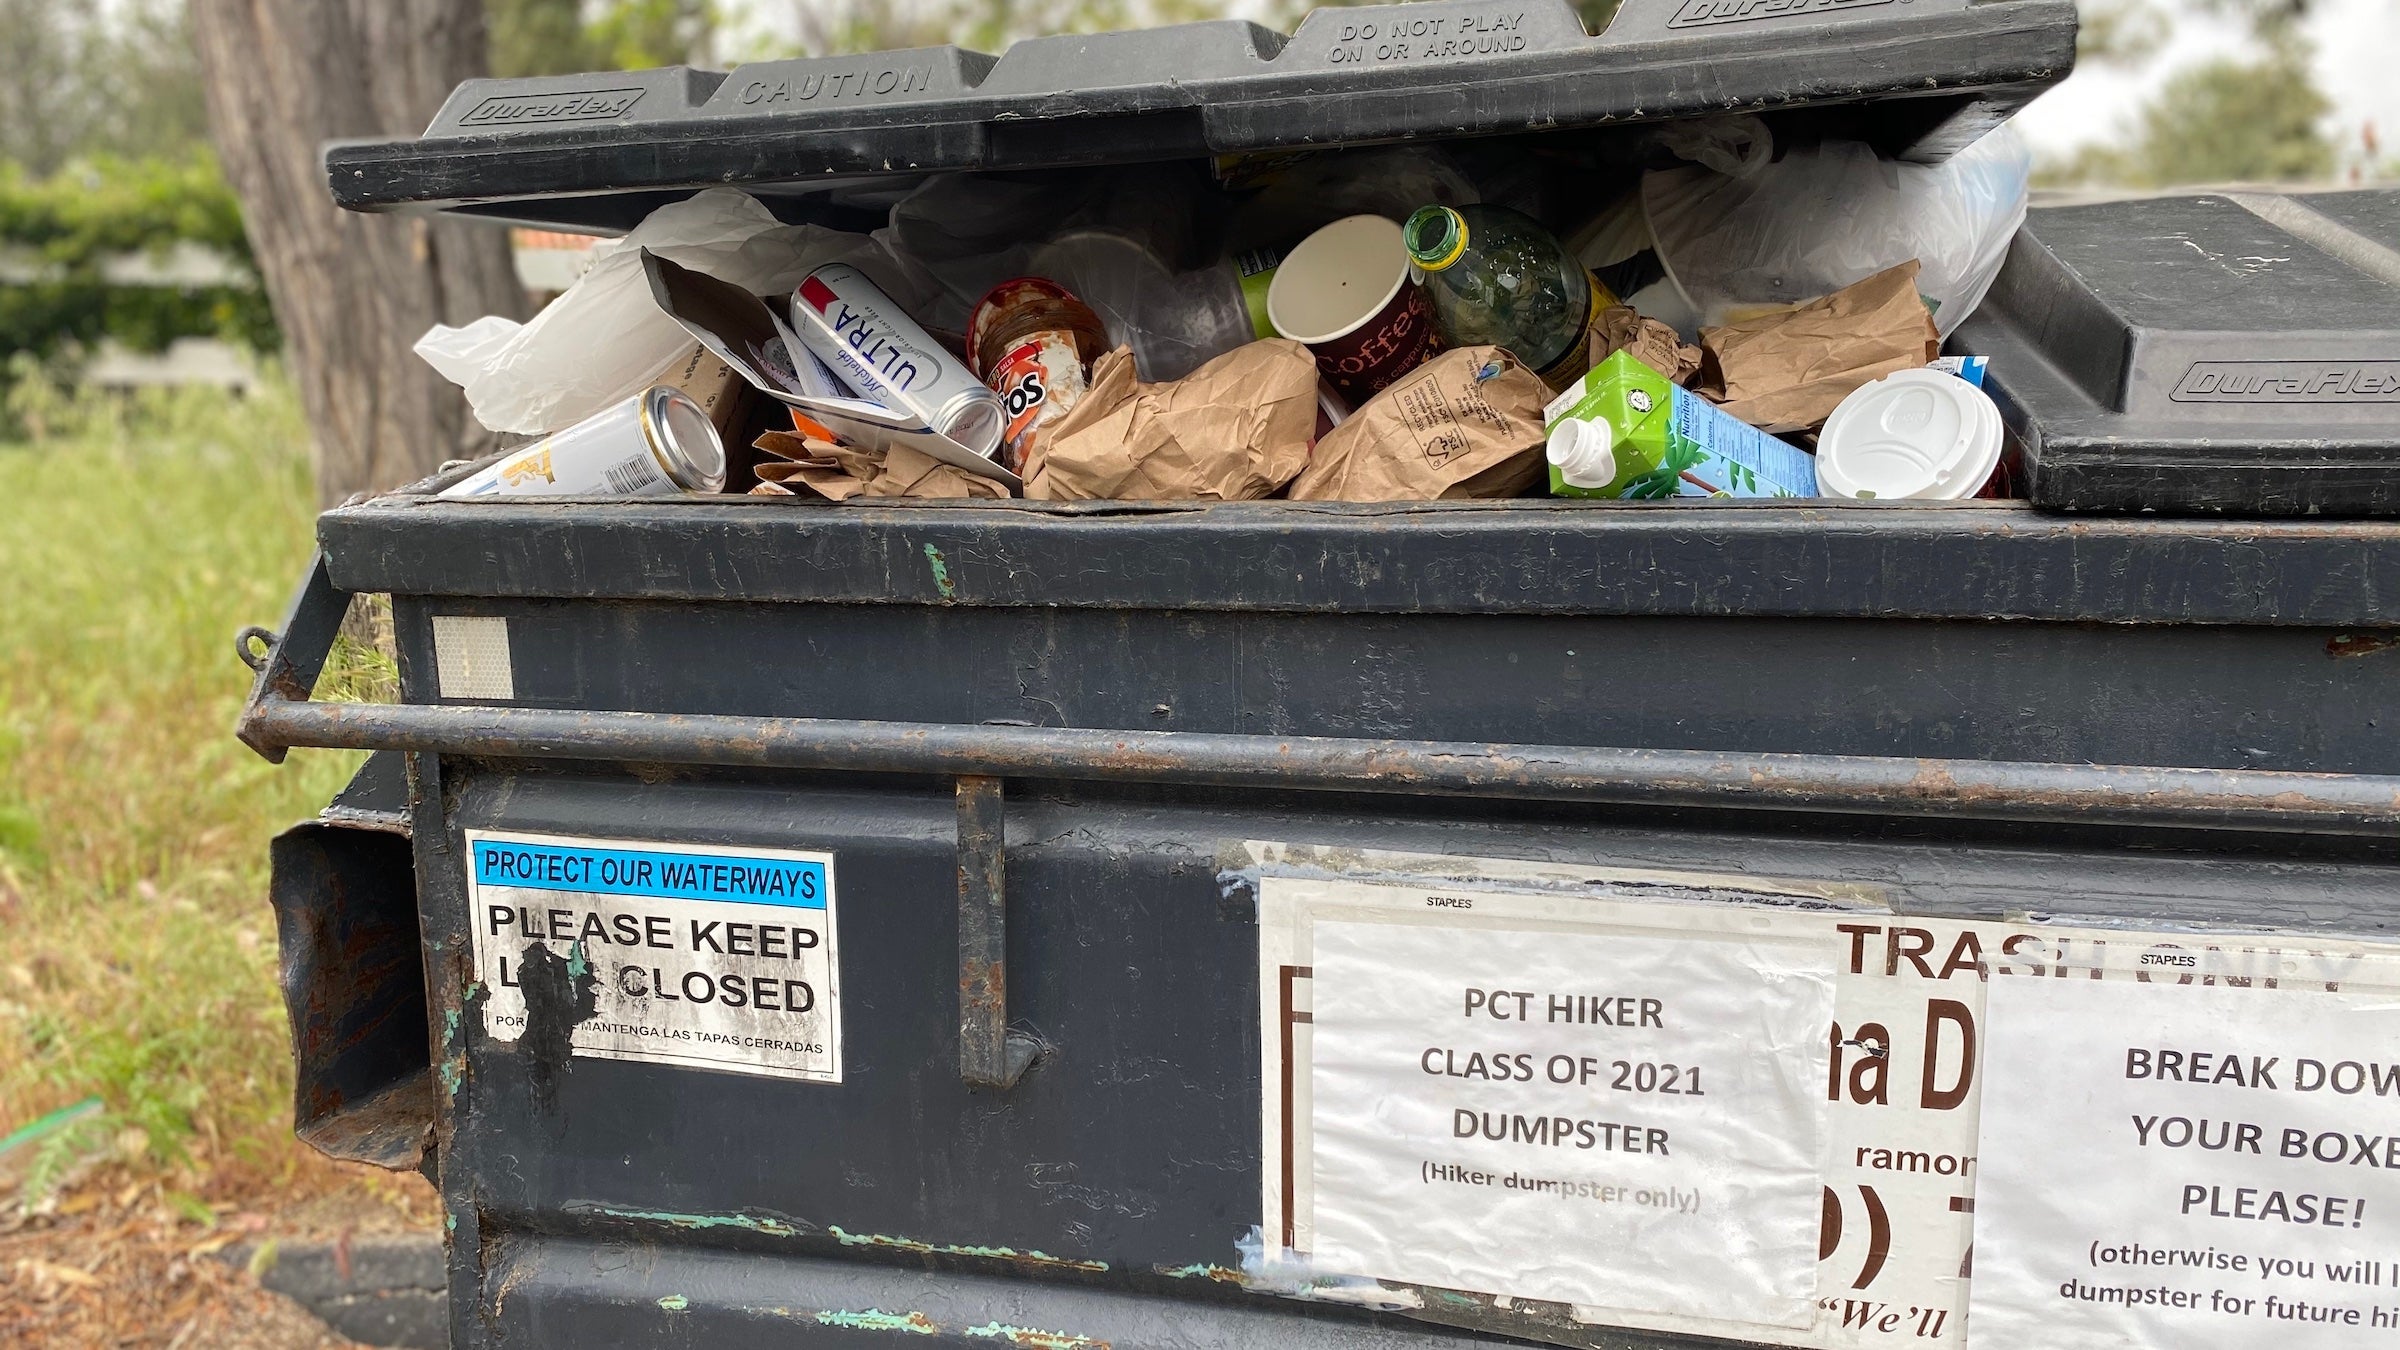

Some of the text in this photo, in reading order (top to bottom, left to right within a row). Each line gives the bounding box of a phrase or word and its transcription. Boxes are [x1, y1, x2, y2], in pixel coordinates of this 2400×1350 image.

[1341, 13, 1525, 42] DO NOT PLAY
[1329, 35, 1527, 63] ON OR AROUND
[741, 64, 932, 105] CAUTION
[833, 303, 917, 393] ULTRA
[837, 349, 890, 402] Michelob
[1402, 394, 1426, 432] RECYCLED
[1680, 393, 1691, 438] Nutrition
[1444, 429, 1460, 451] FSC
[1706, 420, 1714, 449] Calories
[485, 849, 816, 900] PROTECT OUR WATERWAYS
[1426, 896, 1473, 910] STAPLES
[488, 905, 820, 960] PLEASE KEEP
[2140, 953, 2196, 968] STAPLES
[619, 964, 815, 1013] CLOSED
[1464, 988, 1665, 1030] PCT HIKER
[495, 1015, 526, 1027] POR
[581, 1021, 824, 1055] MANTENGA LAS TAPAS CERRADAS
[1420, 1047, 1706, 1097] CLASS OF 2021
[2125, 1048, 2279, 1090] BREAK
[1453, 1108, 1671, 1156] DUMPSTER
[2131, 1114, 2263, 1155] YOUR
[1421, 1160, 1702, 1215] (Hiker dumpster only)
[2180, 1184, 2366, 1229] PLEASE!
[2088, 1240, 2248, 1273] (otherwise
[2258, 1255, 2315, 1280] you
[2325, 1261, 2381, 1287] will
[2059, 1278, 2202, 1314] dumpster
[2210, 1284, 2256, 1316] for
[2264, 1295, 2361, 1326] future
